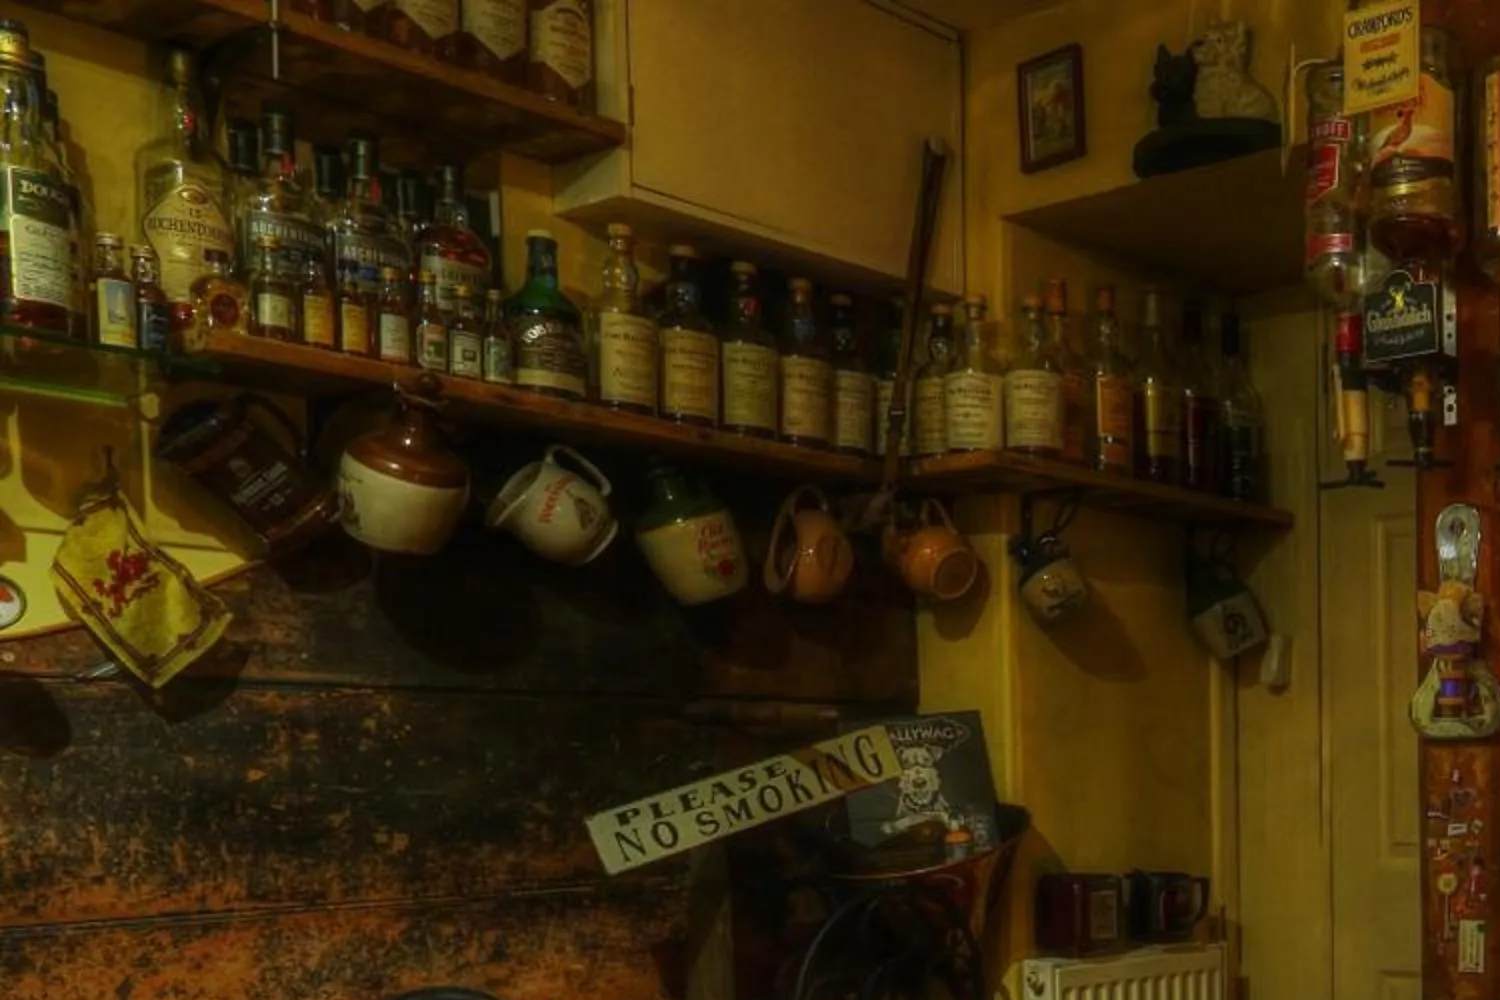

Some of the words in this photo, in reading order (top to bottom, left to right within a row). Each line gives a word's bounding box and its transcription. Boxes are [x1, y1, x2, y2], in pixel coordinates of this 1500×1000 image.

[614, 760, 789, 827] PLEASE
[614, 821, 680, 864] NO
[695, 735, 883, 837] SMOKING
